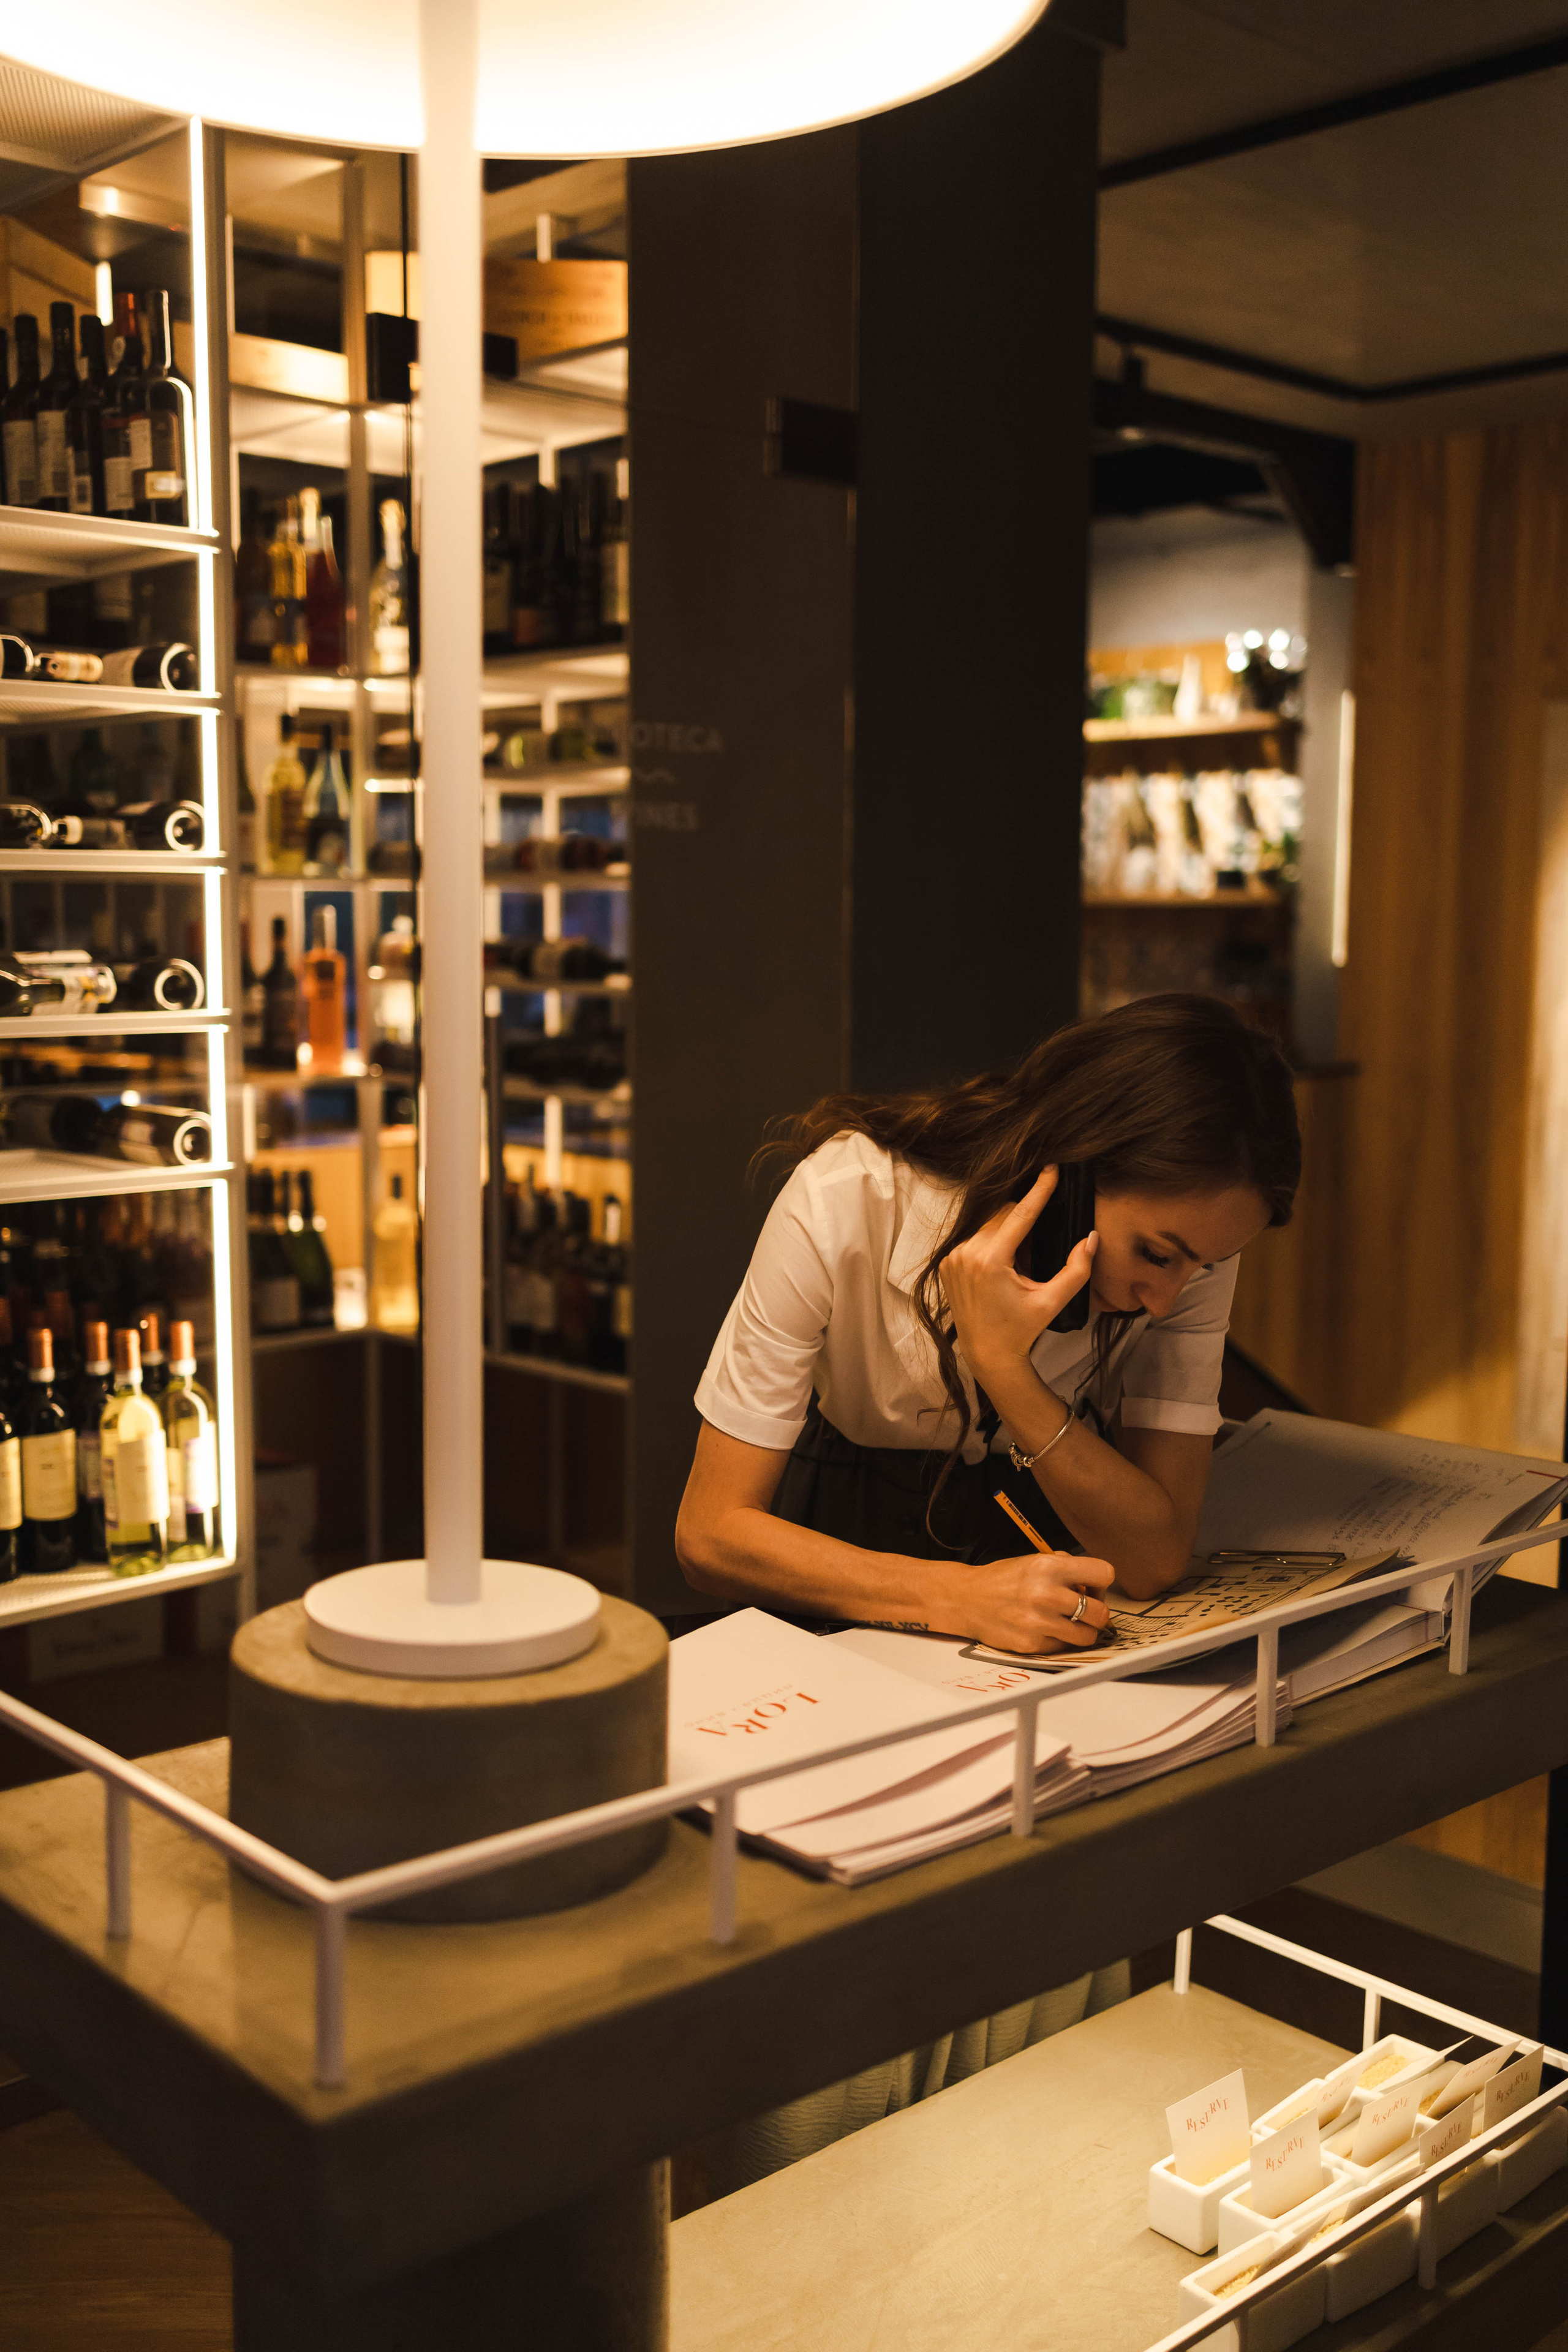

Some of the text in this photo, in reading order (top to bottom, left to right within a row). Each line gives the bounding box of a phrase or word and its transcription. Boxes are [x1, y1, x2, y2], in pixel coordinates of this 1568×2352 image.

[696, 1692, 820, 1736] LORA
[1496, 2070, 1530, 2102] RESERVE
[1186, 2097, 1229, 2132] RESERVE
[1372, 2097, 1410, 2125] RESERVE
[1266, 2136, 1304, 2171] RESERVE
[1431, 2122, 1462, 2157] RESERVE
